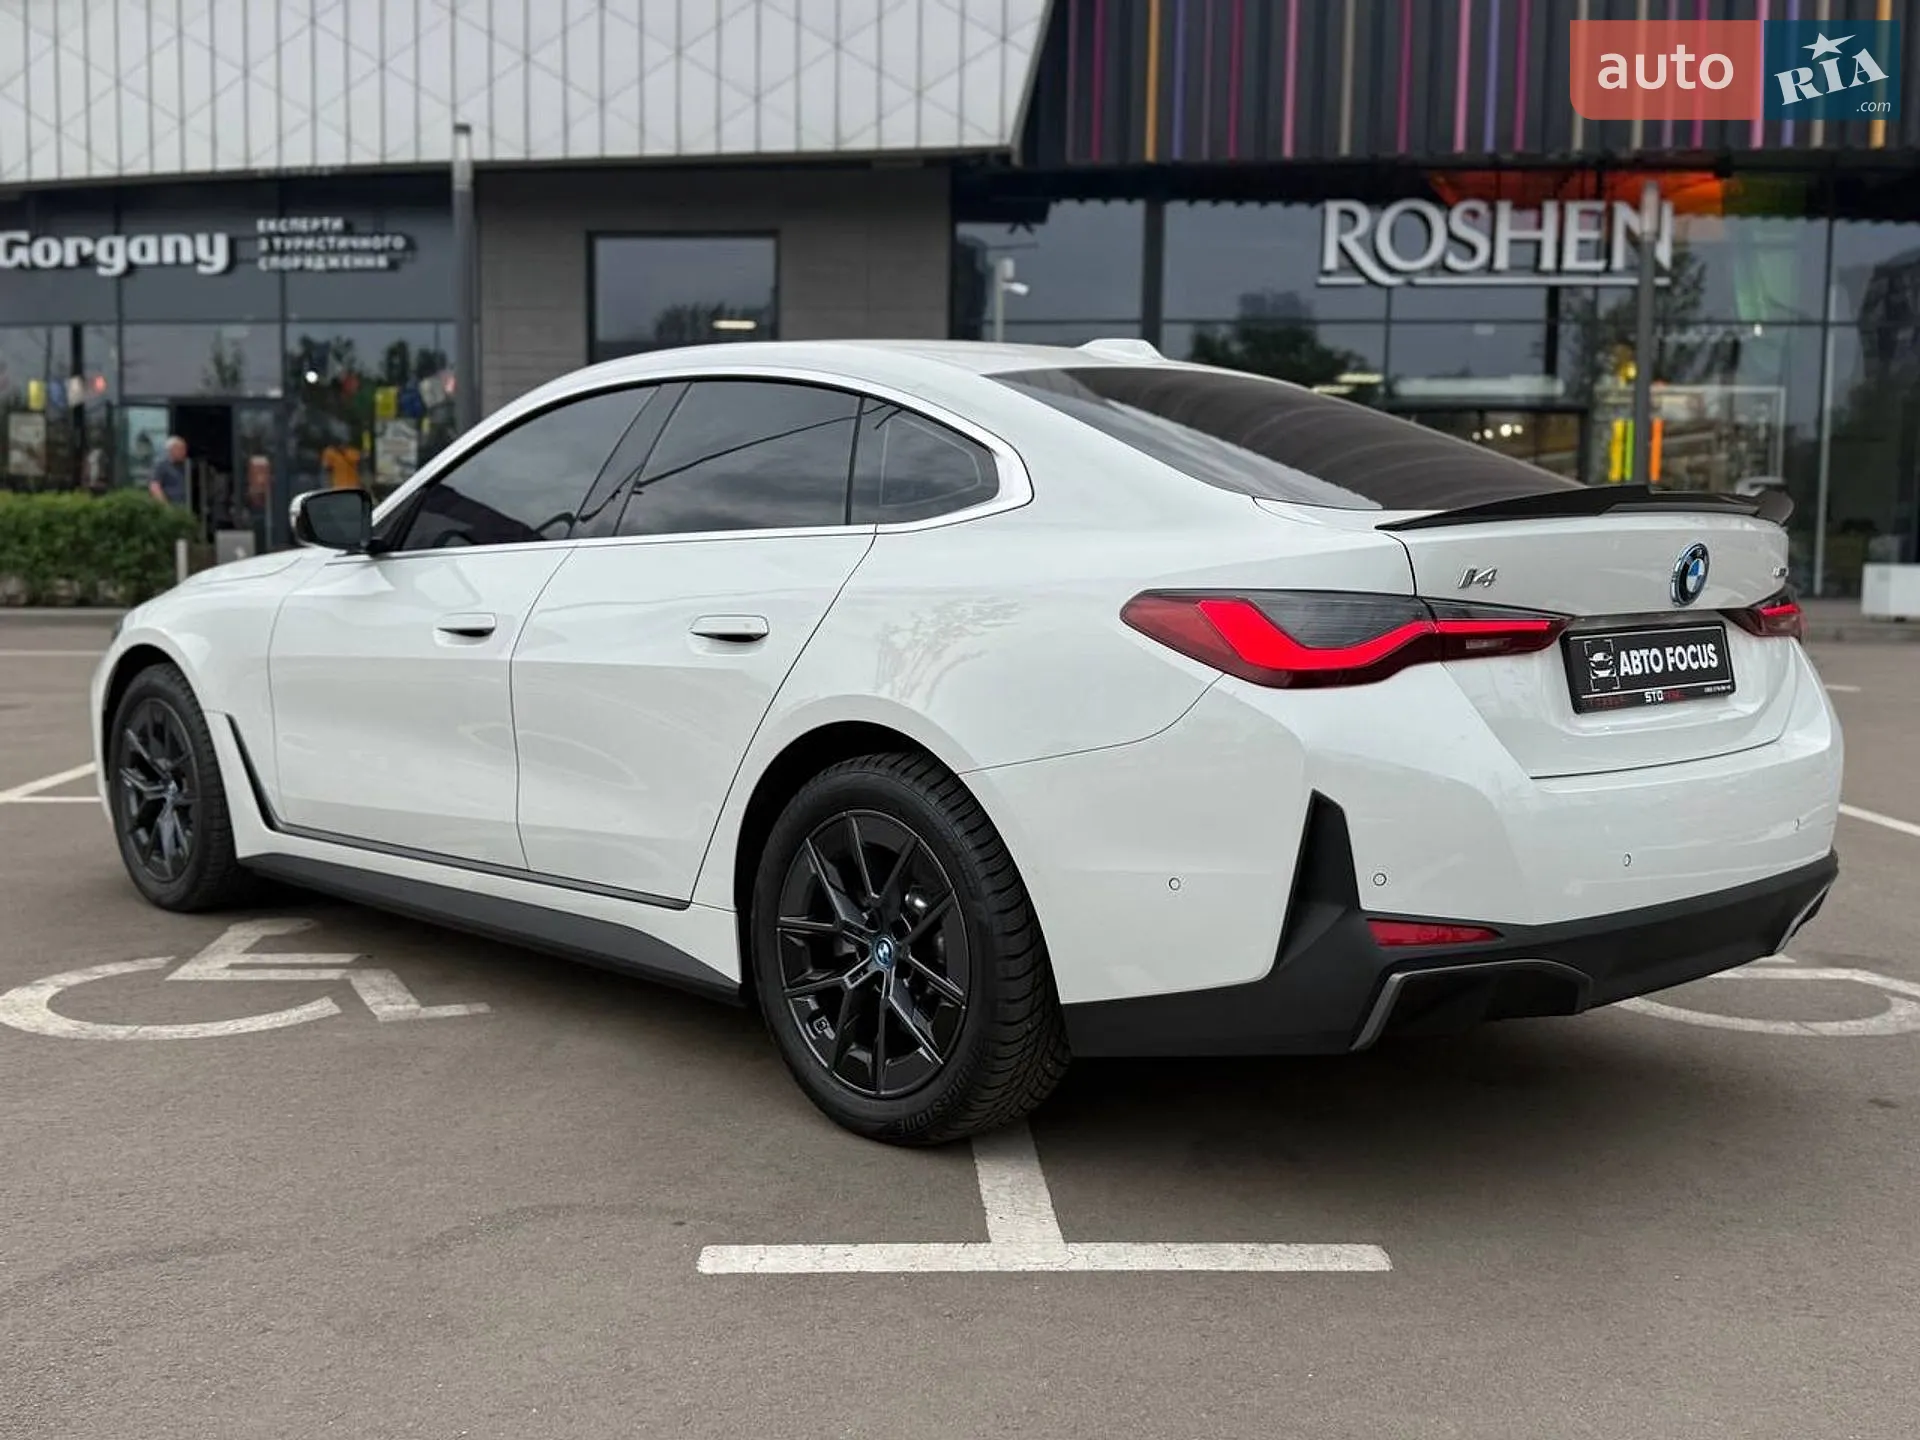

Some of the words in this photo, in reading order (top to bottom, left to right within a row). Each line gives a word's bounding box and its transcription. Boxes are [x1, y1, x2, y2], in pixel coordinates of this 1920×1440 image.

[0, 230, 229, 277] Gorgany
[1321, 198, 1674, 286] ROSHEN
[1666, 643, 1718, 671] FOCUS
